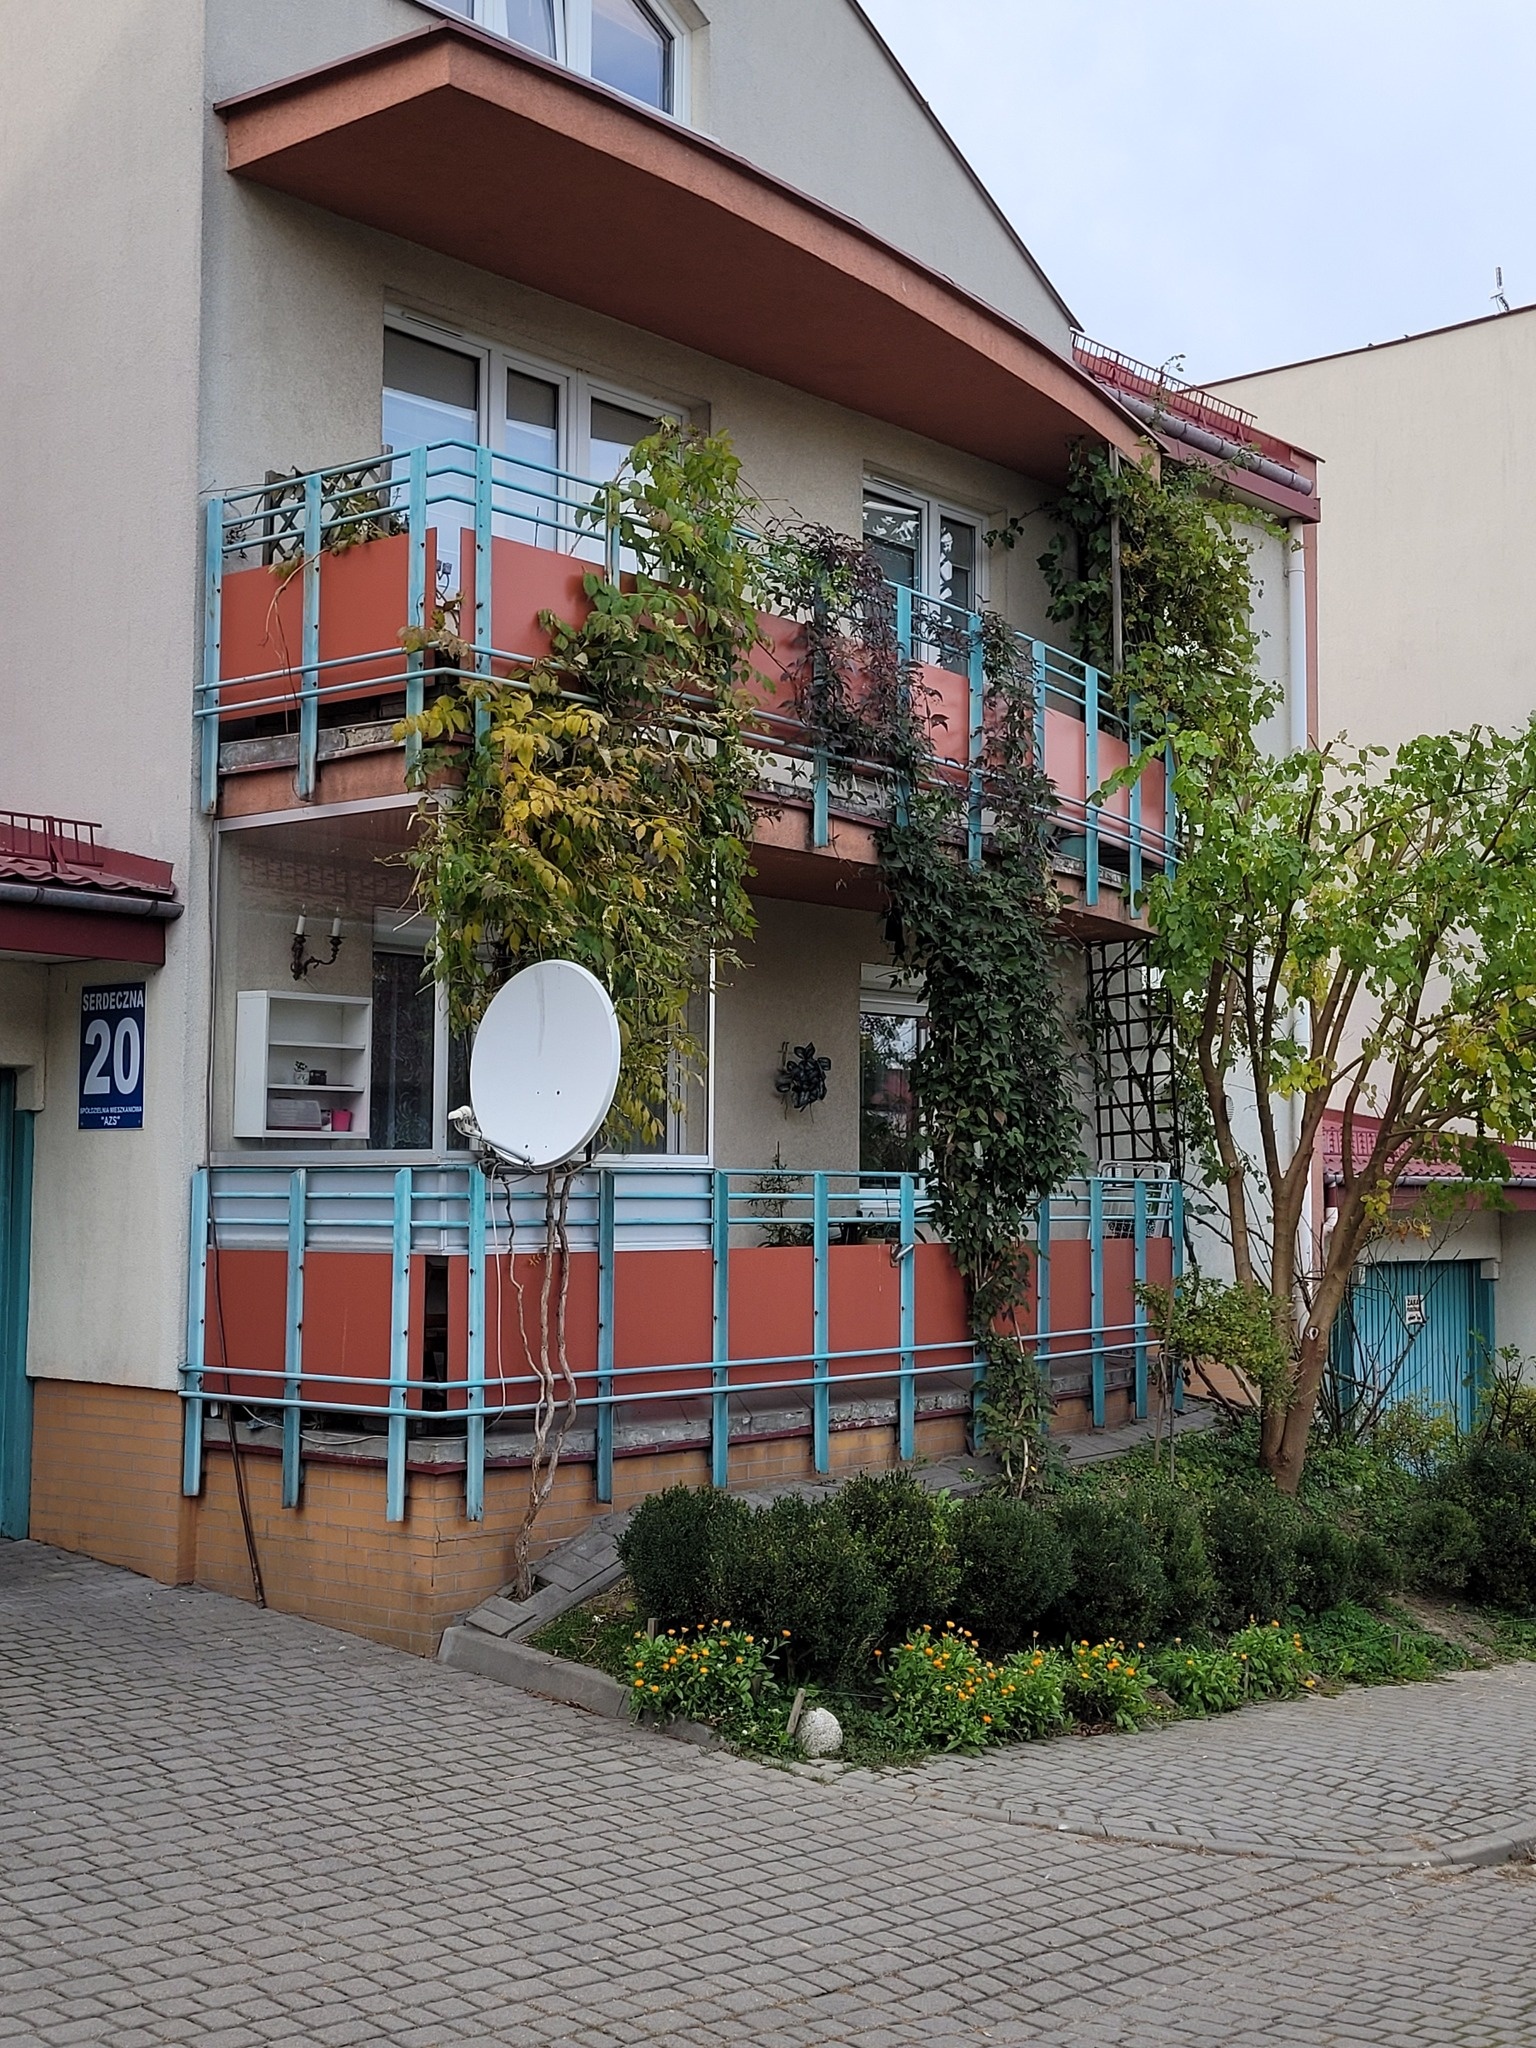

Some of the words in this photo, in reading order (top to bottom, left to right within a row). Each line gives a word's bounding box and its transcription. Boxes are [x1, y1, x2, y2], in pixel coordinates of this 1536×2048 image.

[82, 989, 144, 1012] SERDECZNA
[83, 1017, 141, 1095] 20
[101, 1115, 120, 1126] "AZS"
